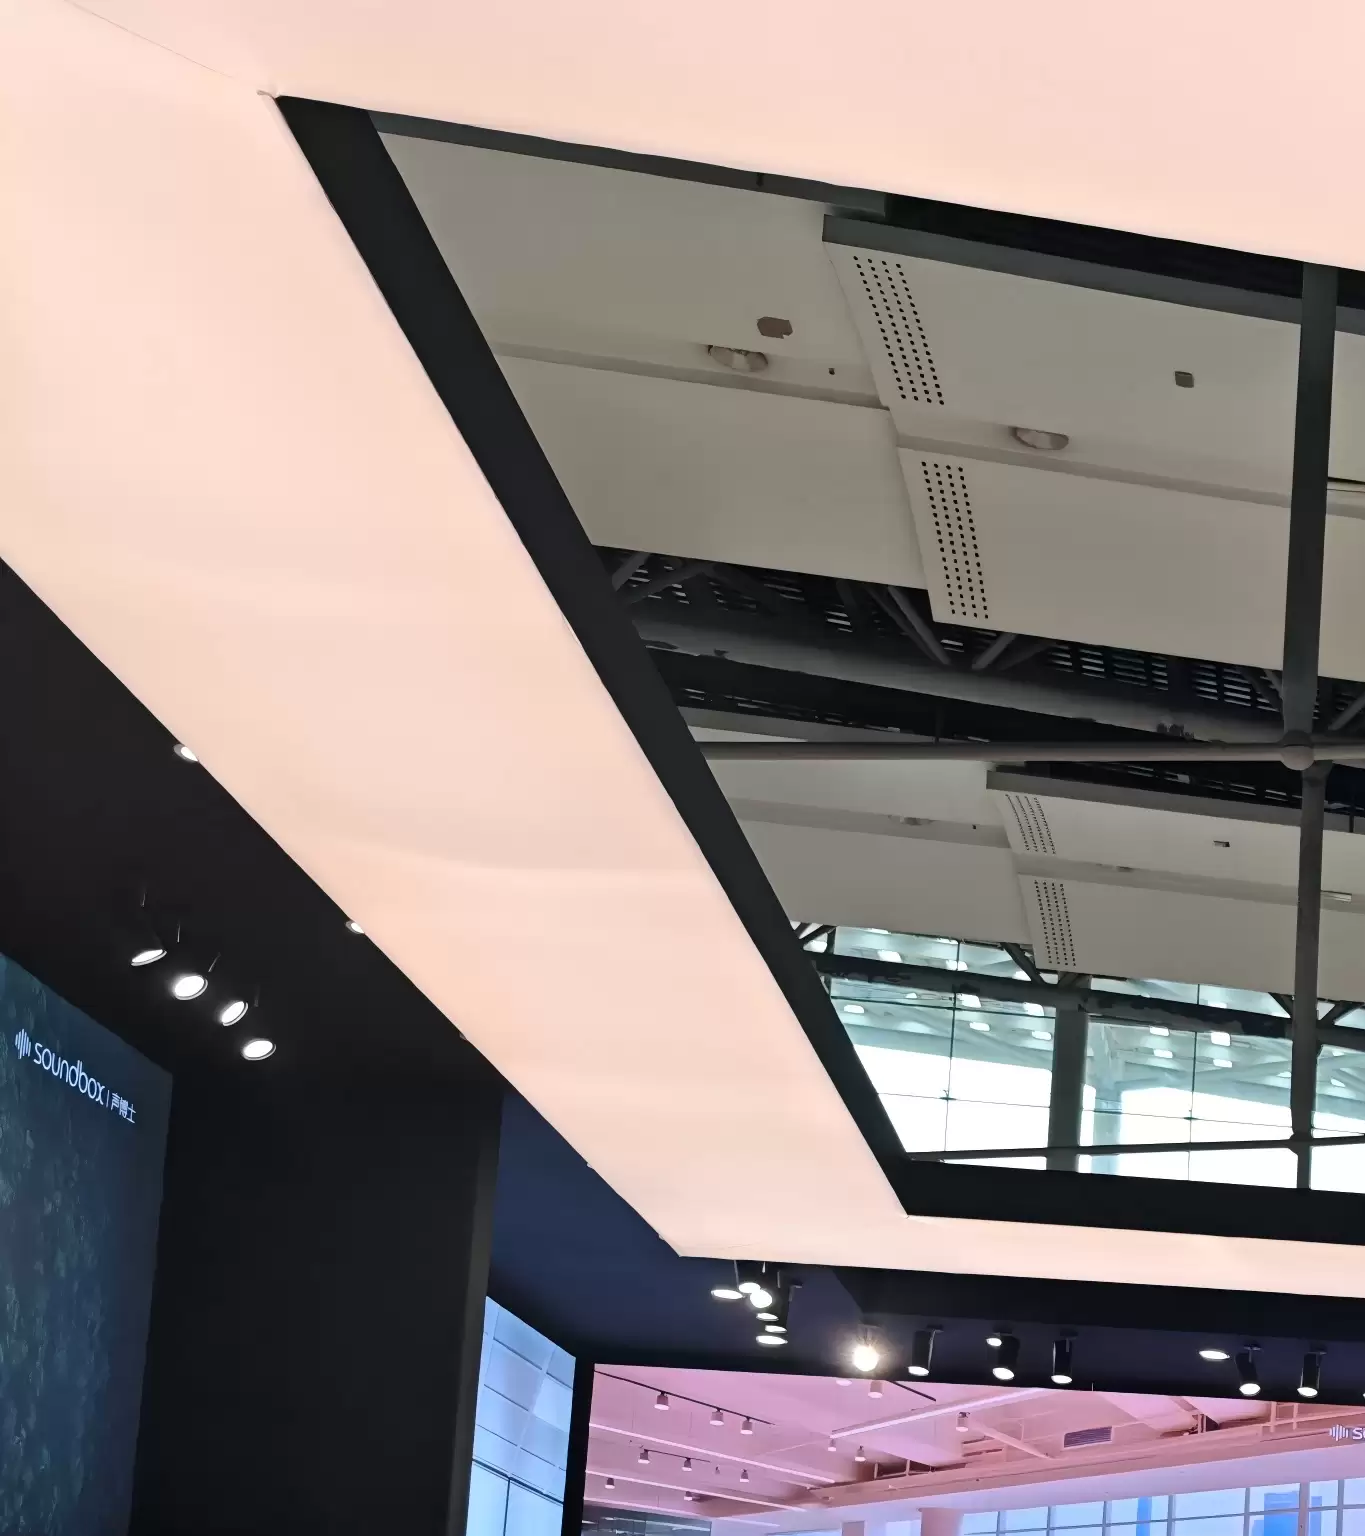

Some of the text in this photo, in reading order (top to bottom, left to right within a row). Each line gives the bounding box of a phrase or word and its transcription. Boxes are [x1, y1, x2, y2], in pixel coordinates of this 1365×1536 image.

[33, 1042, 137, 1124] soundbox 声博士
